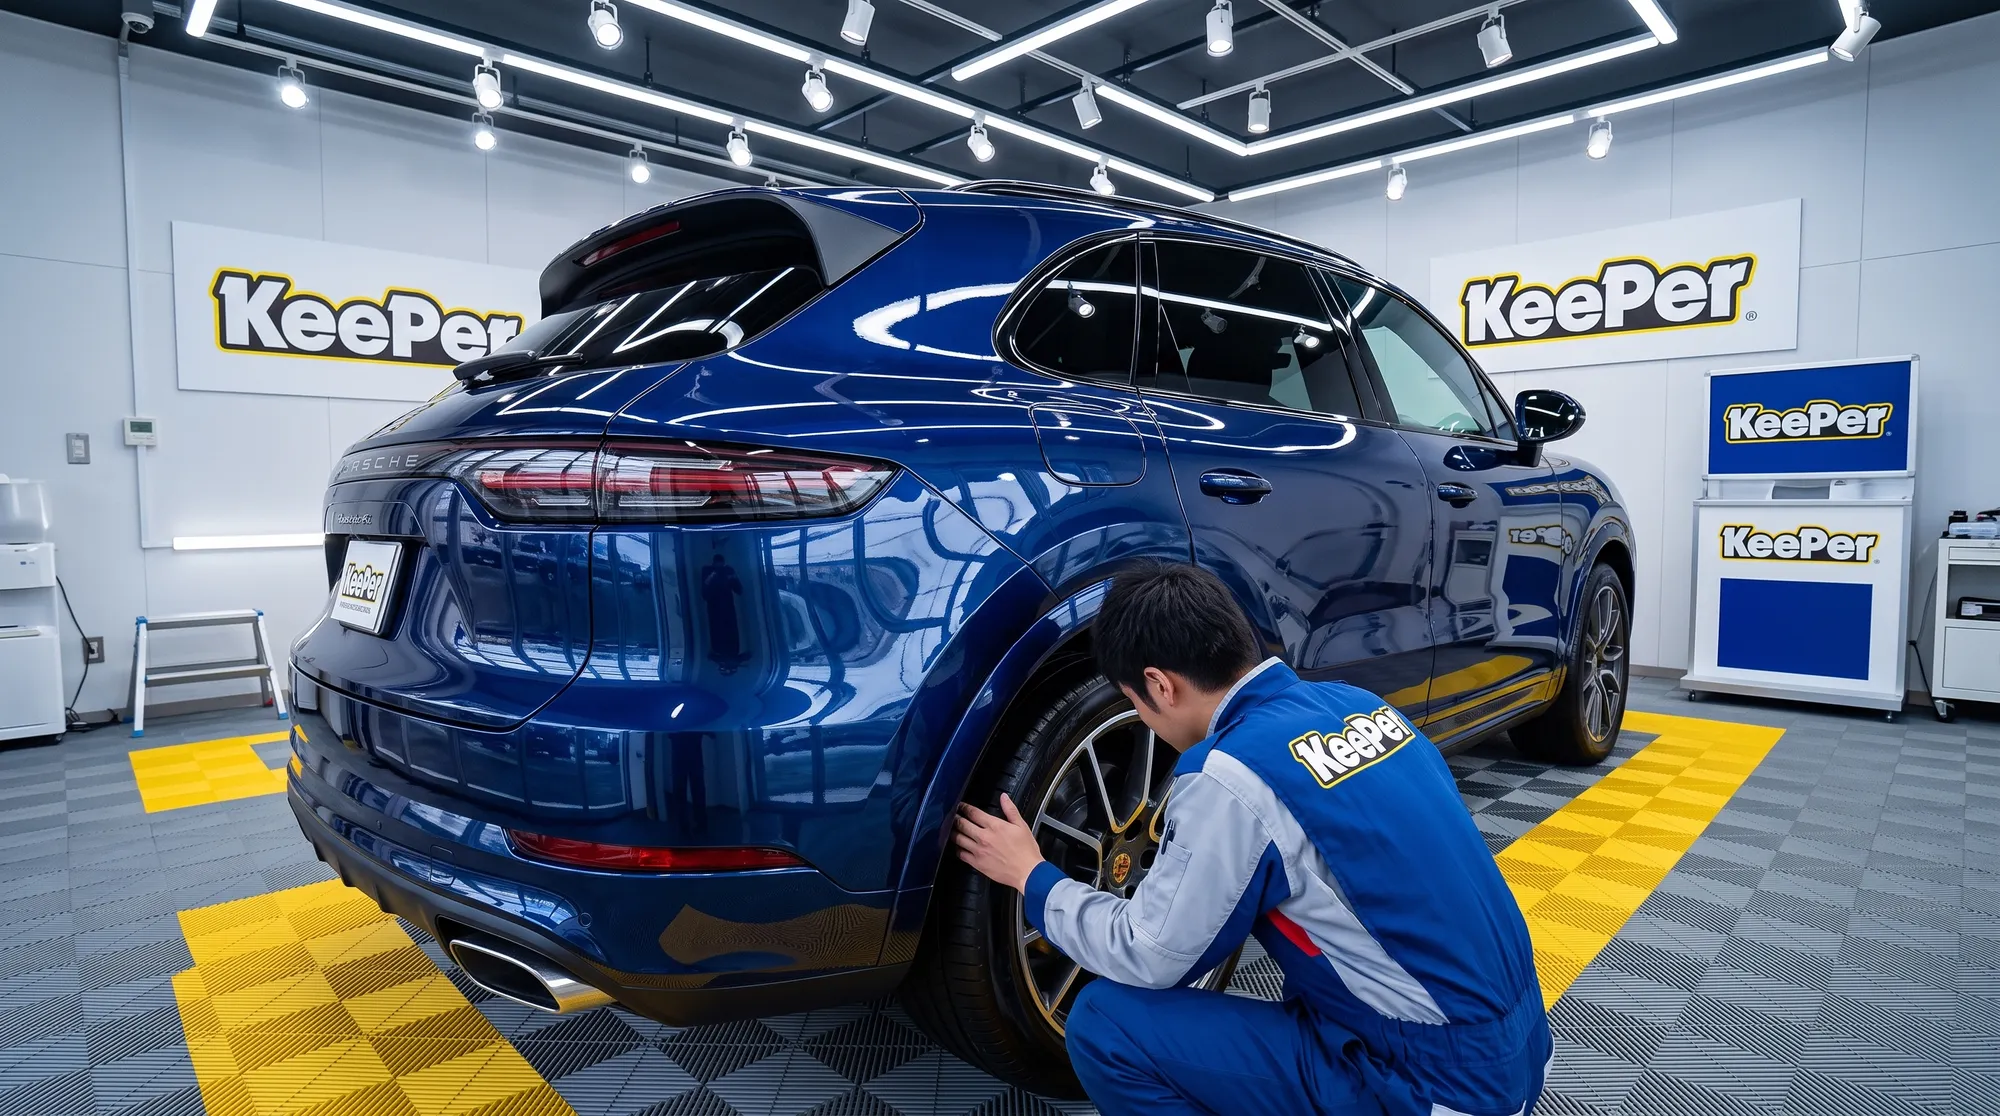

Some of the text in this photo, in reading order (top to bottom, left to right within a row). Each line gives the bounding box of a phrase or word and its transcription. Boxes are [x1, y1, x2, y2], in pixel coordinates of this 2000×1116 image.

[213, 271, 522, 366] KeePer
[1464, 257, 1754, 345] KeePer
[1726, 402, 1890, 441] KeePer
[1721, 526, 1878, 562] KeePer
[341, 563, 384, 602] KeePer
[1292, 707, 1414, 786] KeePer
